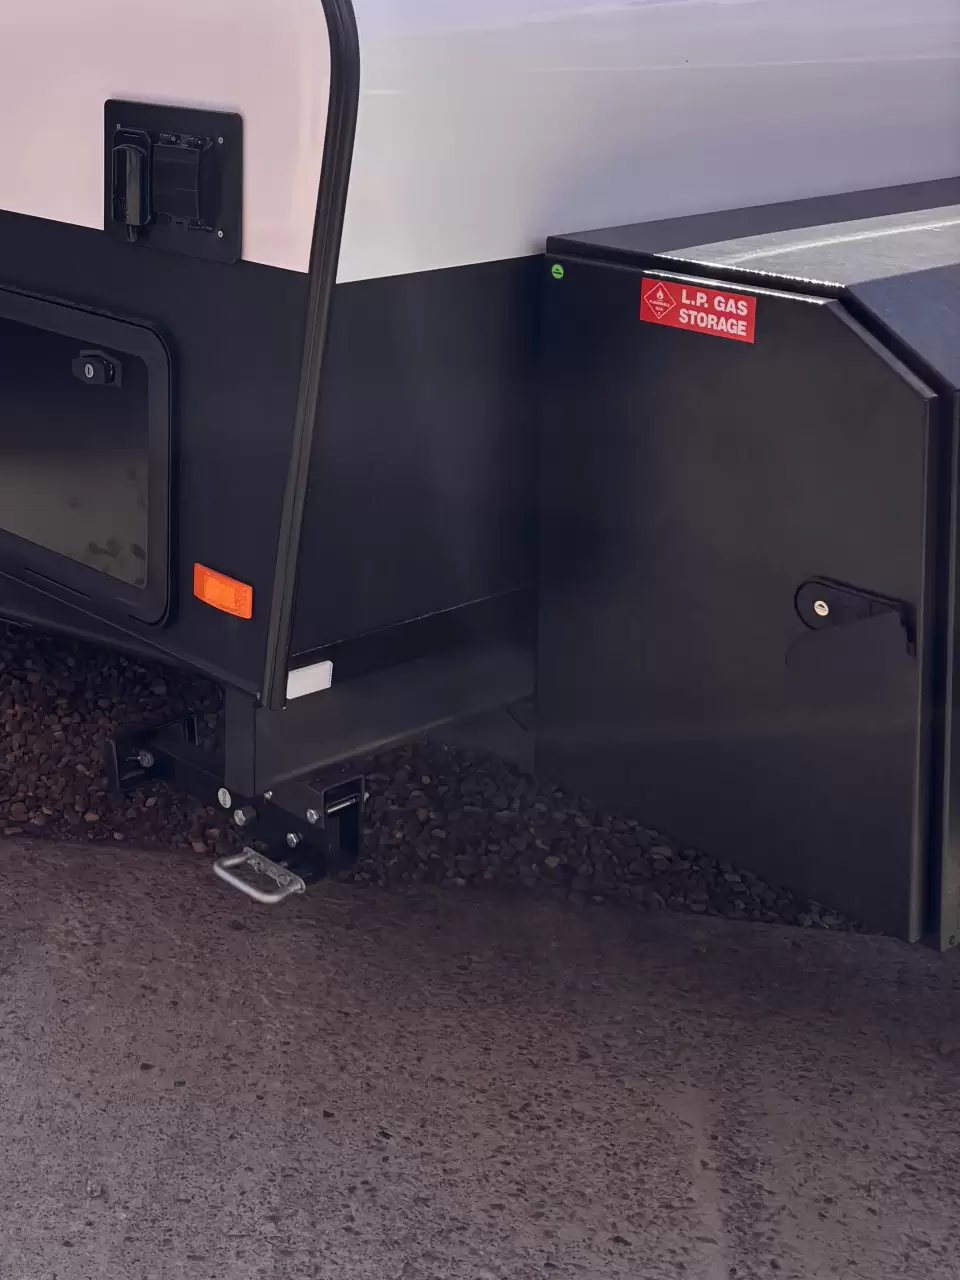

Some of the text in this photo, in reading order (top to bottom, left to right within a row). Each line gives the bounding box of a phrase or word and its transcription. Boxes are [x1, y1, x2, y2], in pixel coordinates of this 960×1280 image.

[681, 289, 748, 316] L.P. GAS
[678, 308, 748, 337] STORAGE
